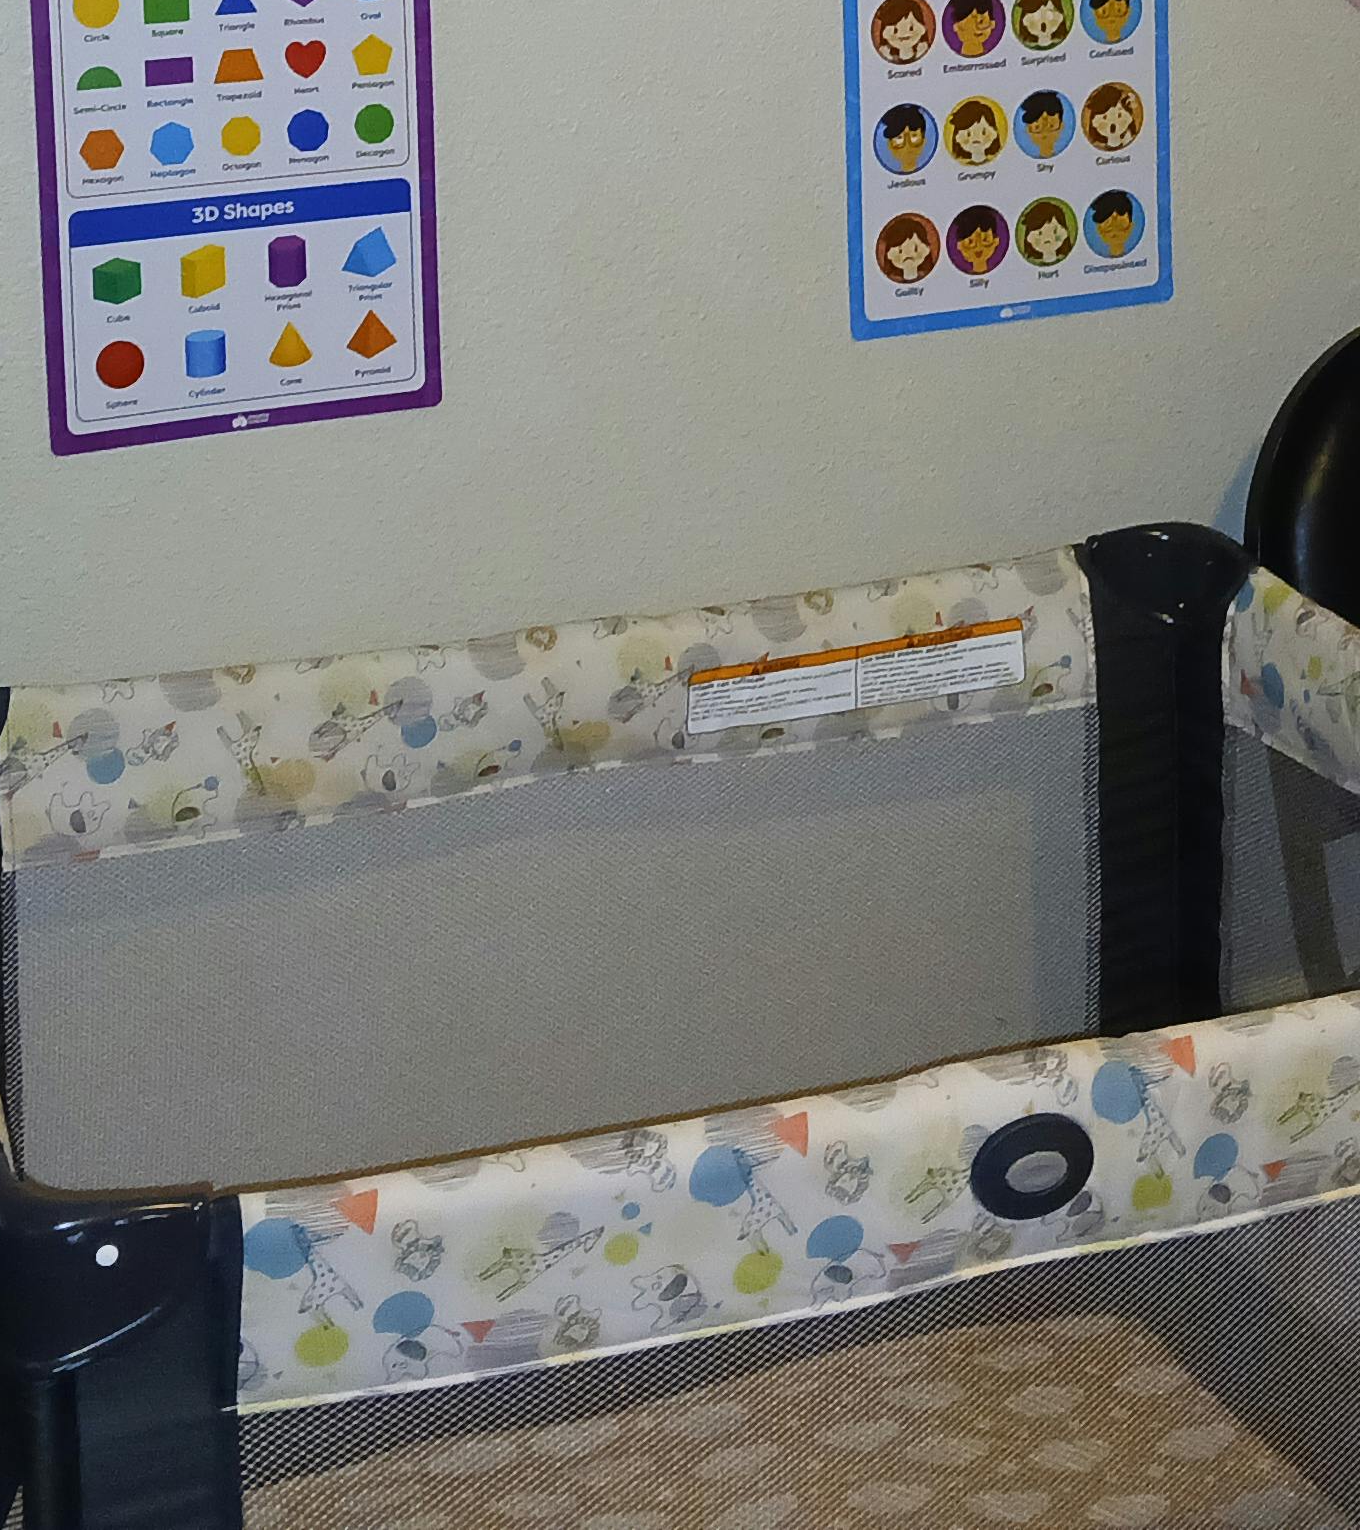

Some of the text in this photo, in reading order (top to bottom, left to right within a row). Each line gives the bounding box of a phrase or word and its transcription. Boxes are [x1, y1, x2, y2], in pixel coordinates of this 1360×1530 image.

[219, 22, 255, 33] Triangle
[84, 34, 110, 43] Circle
[1089, 47, 1134, 58] Confused
[1021, 53, 1066, 67] Surprised
[943, 59, 1007, 74] Embarrassed
[888, 68, 922, 80] Scared
[146, 96, 194, 108] Rectangle
[1096, 154, 1130, 166] Curious
[957, 171, 995, 182] Grumpy
[888, 178, 926, 190] Jealous
[191, 199, 295, 224] 3D Shapes
